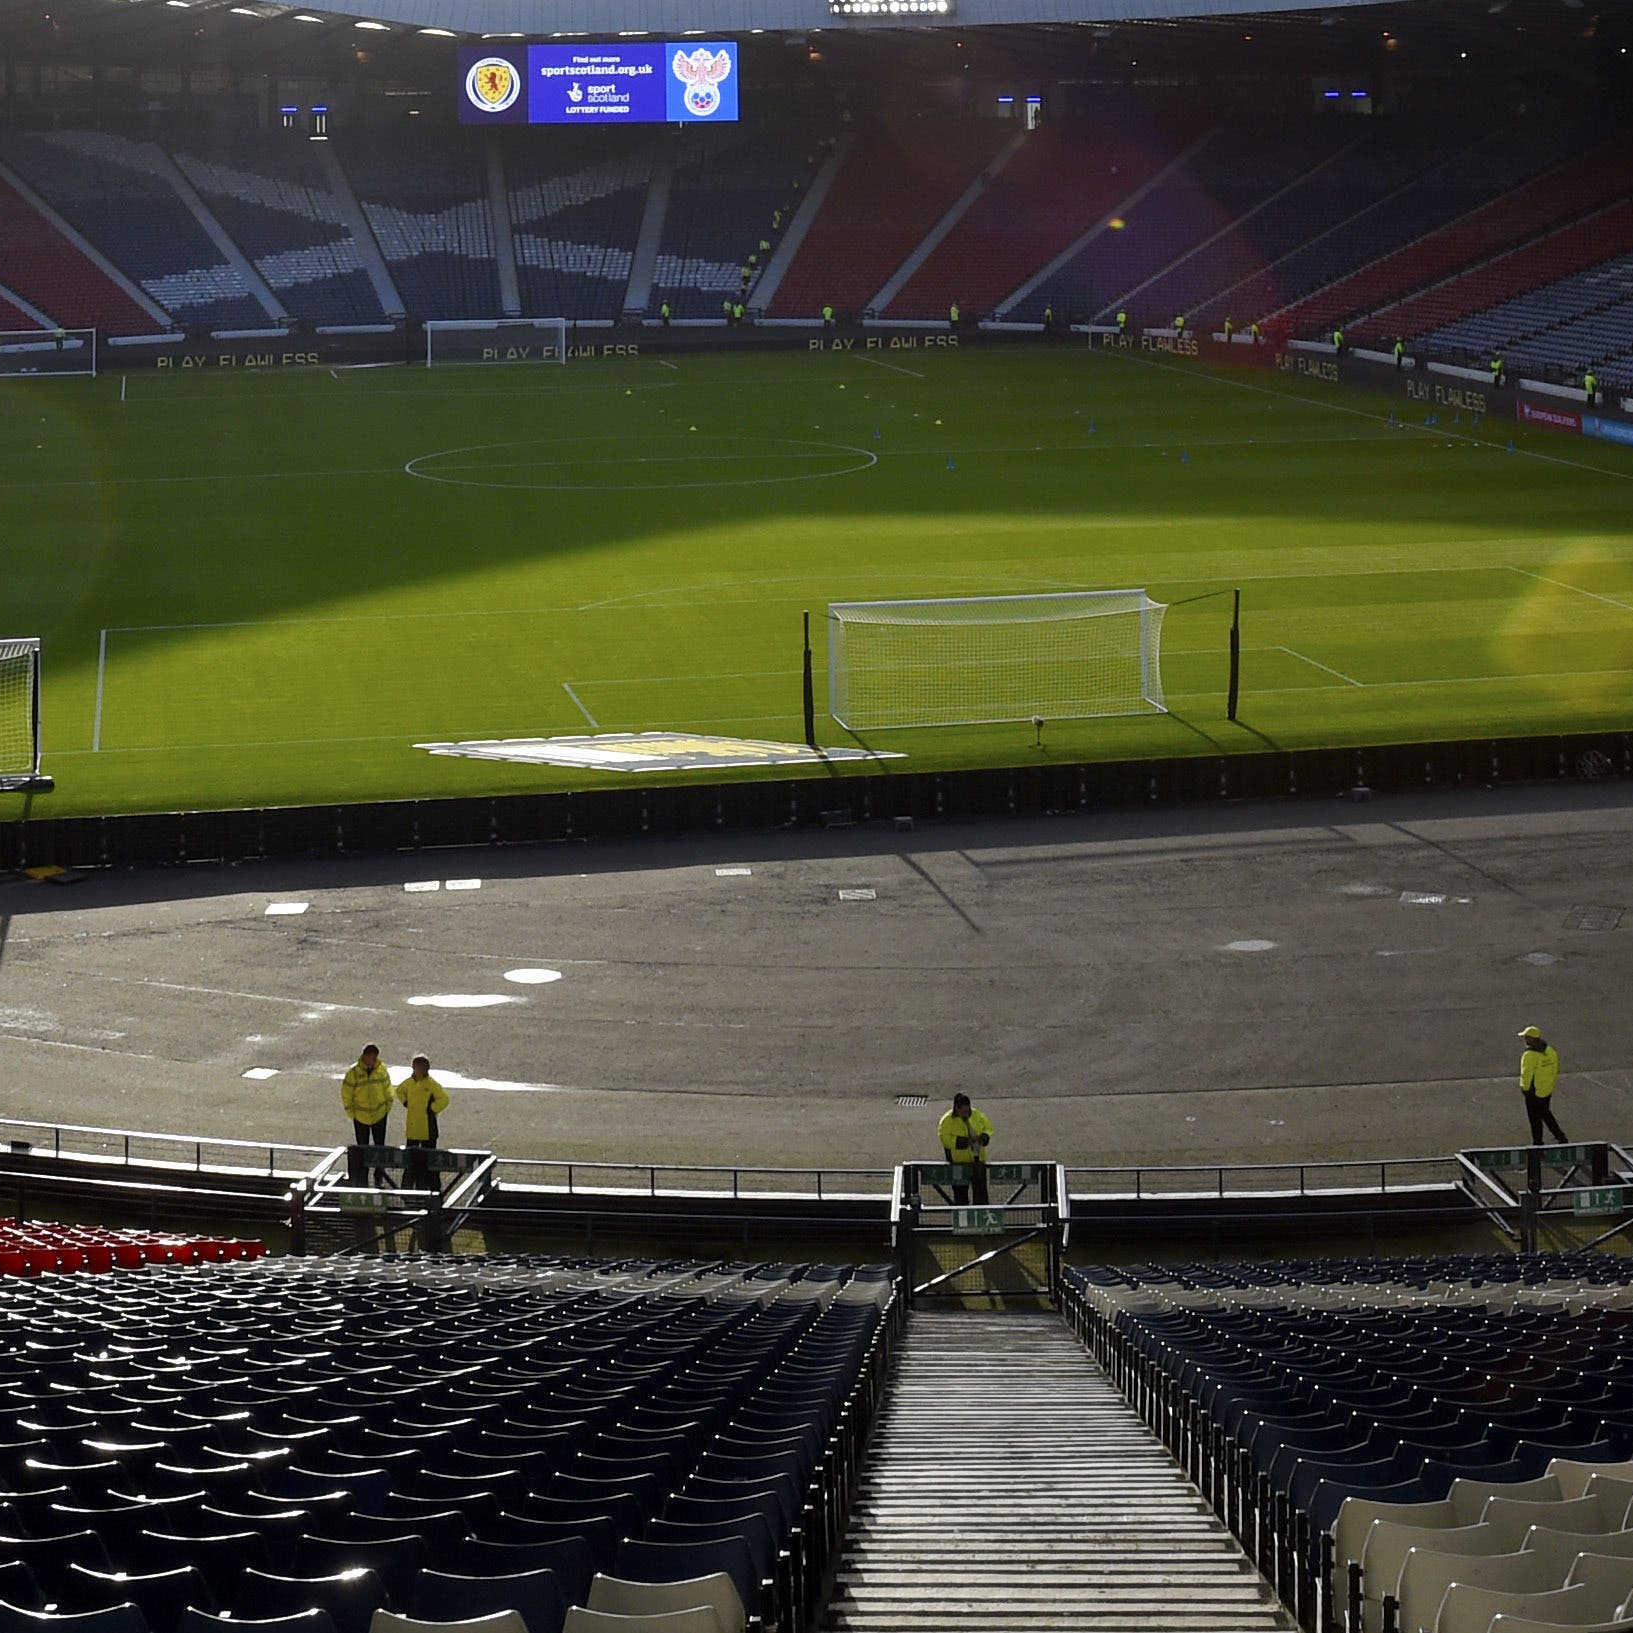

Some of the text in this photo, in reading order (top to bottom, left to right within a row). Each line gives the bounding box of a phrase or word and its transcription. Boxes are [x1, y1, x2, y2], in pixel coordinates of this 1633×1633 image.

[541, 64, 652, 77] sportscotland.org.uk
[587, 84, 615, 95] sport
[587, 93, 629, 103] scotland
[566, 106, 598, 114] LOTTERY
[1104, 333, 1198, 356] PLAY FLAWLESS
[1275, 352, 1338, 381] PLAY FLAWLESS
[1407, 380, 1486, 413] PLAY FLAWLESS
